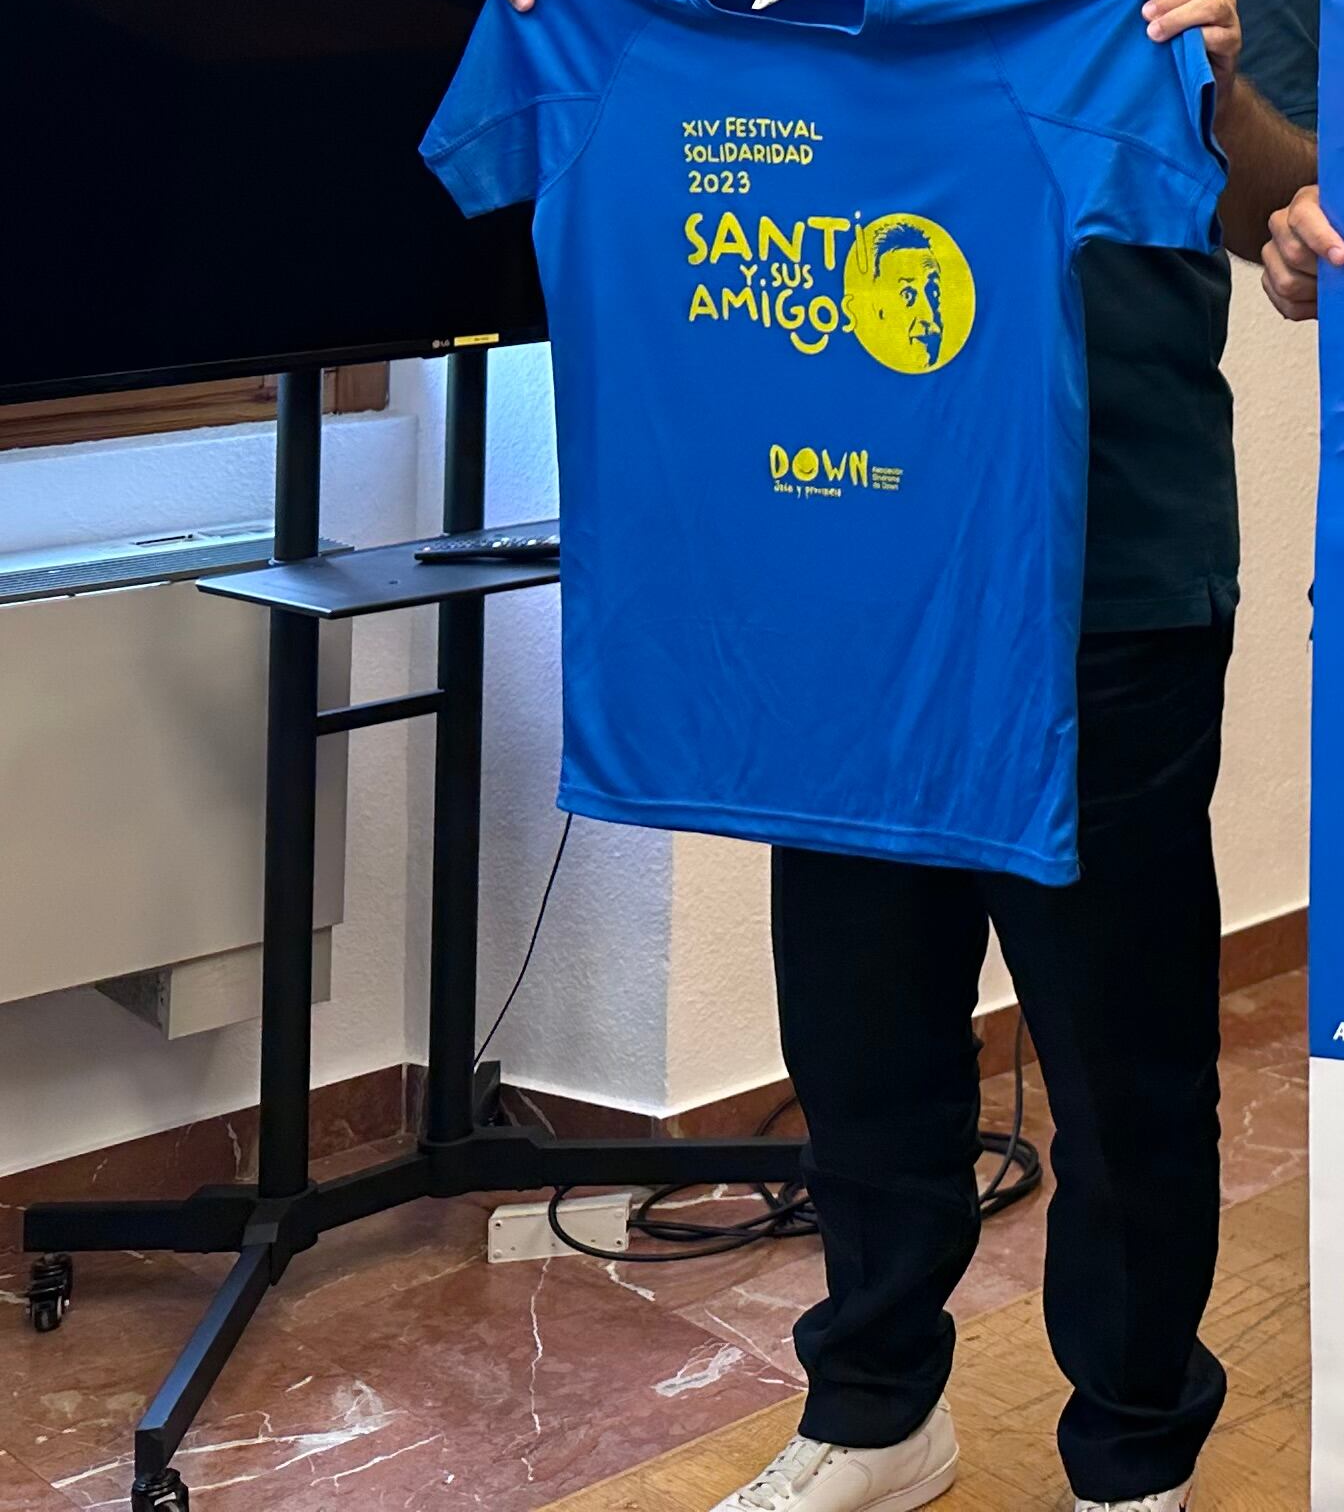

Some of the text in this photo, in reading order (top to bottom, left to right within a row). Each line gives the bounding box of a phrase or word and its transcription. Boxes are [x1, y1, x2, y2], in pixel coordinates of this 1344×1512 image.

[682, 117, 823, 141] XIV FESTIVAL
[684, 143, 813, 165] SOLIDARIDAD
[688, 170, 751, 194] 2023
[740, 262, 813, 288] Y SUS
[769, 444, 868, 488] DOWN
